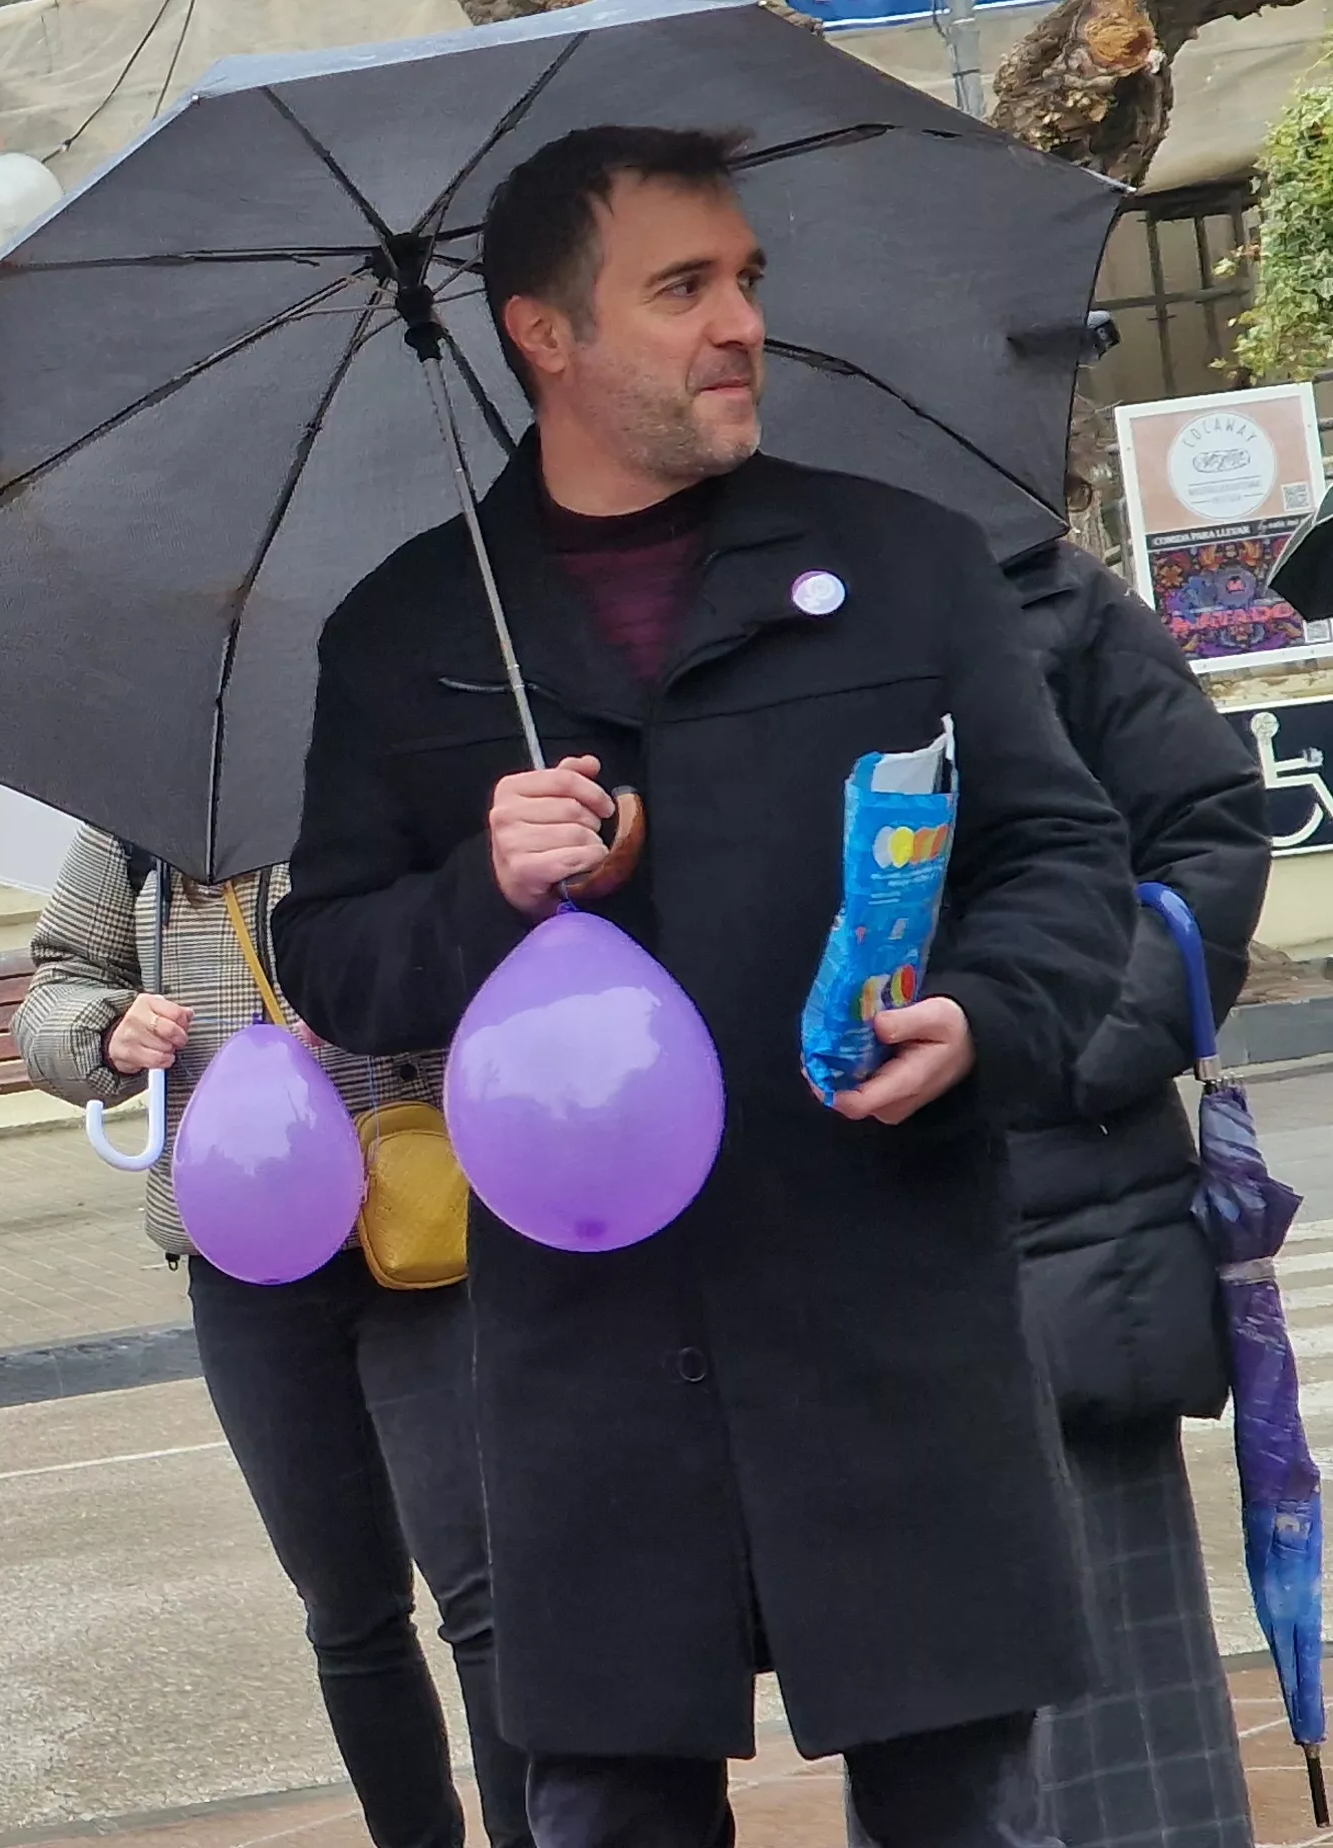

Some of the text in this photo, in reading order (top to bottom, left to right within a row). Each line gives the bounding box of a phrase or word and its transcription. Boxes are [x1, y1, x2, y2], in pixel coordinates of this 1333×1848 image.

[1183, 417, 1258, 448] COCAWAY
[1153, 532, 1190, 546] COMIDA
[1190, 529, 1215, 541] PARA
[1215, 524, 1251, 538] LLEVAR
